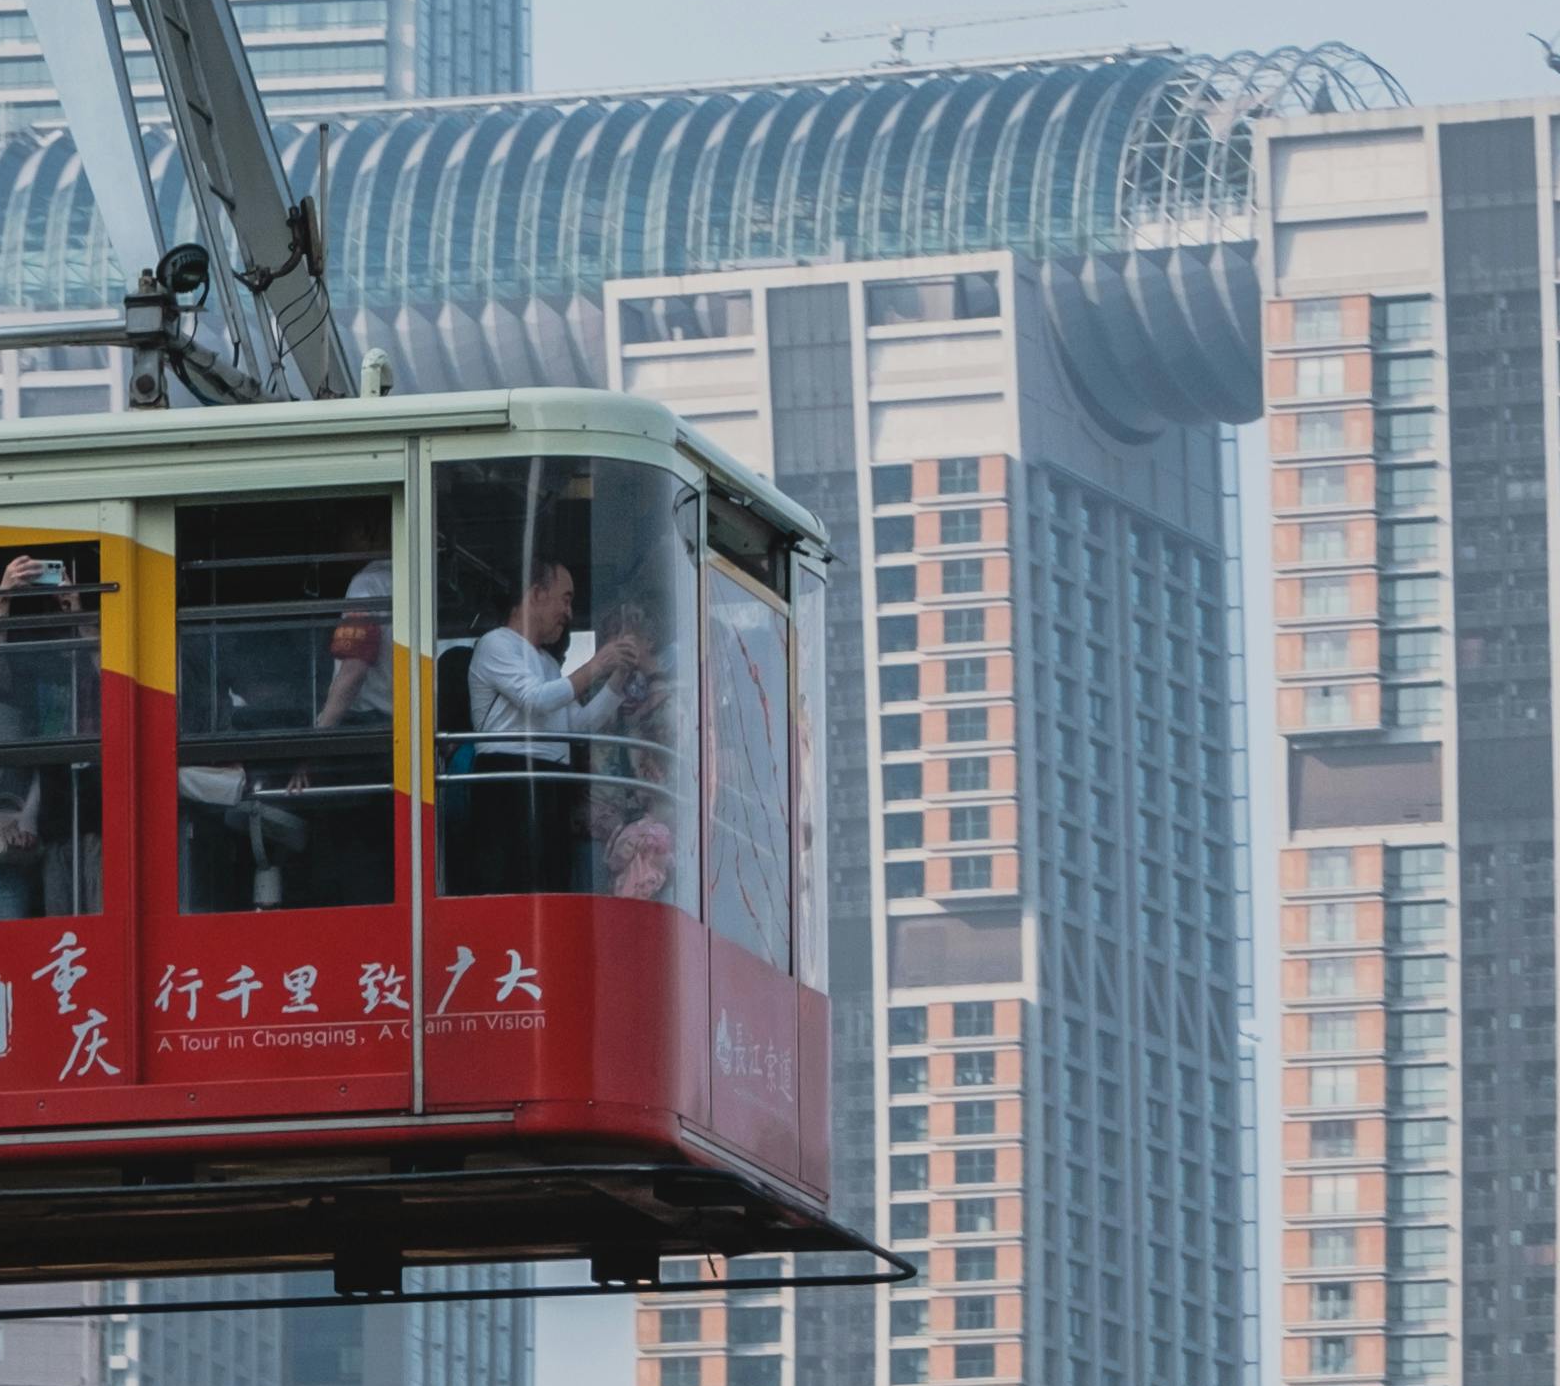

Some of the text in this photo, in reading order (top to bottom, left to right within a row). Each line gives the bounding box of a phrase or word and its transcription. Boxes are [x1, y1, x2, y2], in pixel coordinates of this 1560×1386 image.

[31, 931, 121, 1082] 重庆
[157, 1036, 174, 1053] A
[179, 1034, 221, 1052] Tour
[228, 1032, 245, 1049] in
[378, 1024, 394, 1041] A
[461, 1015, 477, 1032] in
[484, 1014, 546, 1031] Vision
